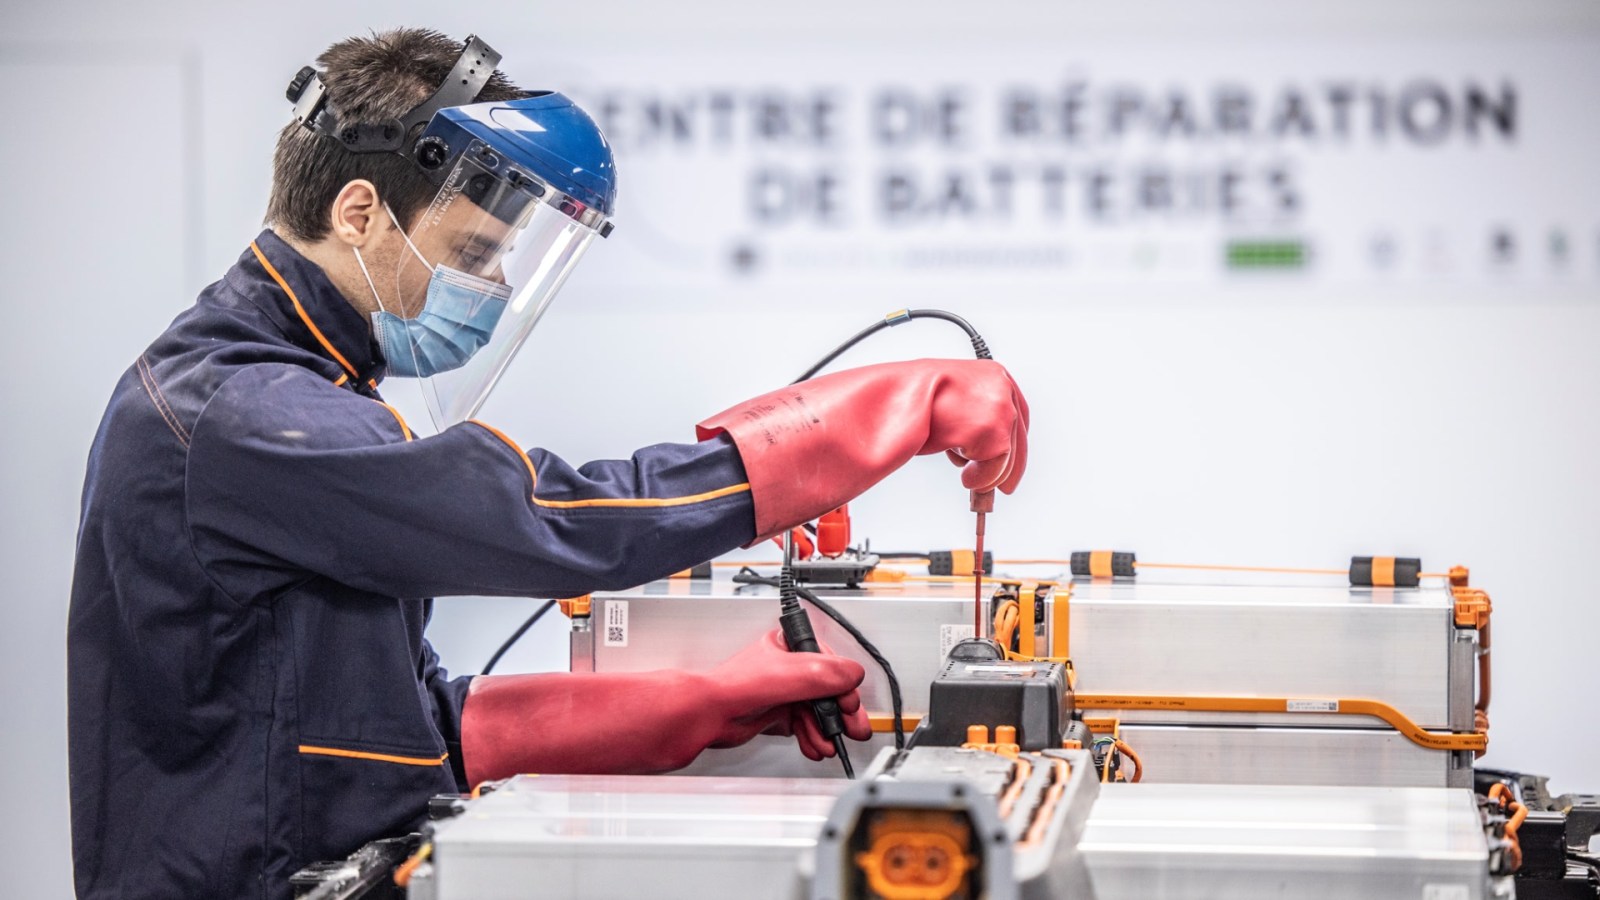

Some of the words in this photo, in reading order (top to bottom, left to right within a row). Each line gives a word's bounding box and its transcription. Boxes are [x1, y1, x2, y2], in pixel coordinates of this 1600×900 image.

[596, 87, 842, 147] ENTRE
[873, 86, 968, 147] DE
[1001, 69, 1518, 145] RÉPARATION
[746, 165, 845, 224] DE
[876, 163, 1304, 219] BATTERIES
